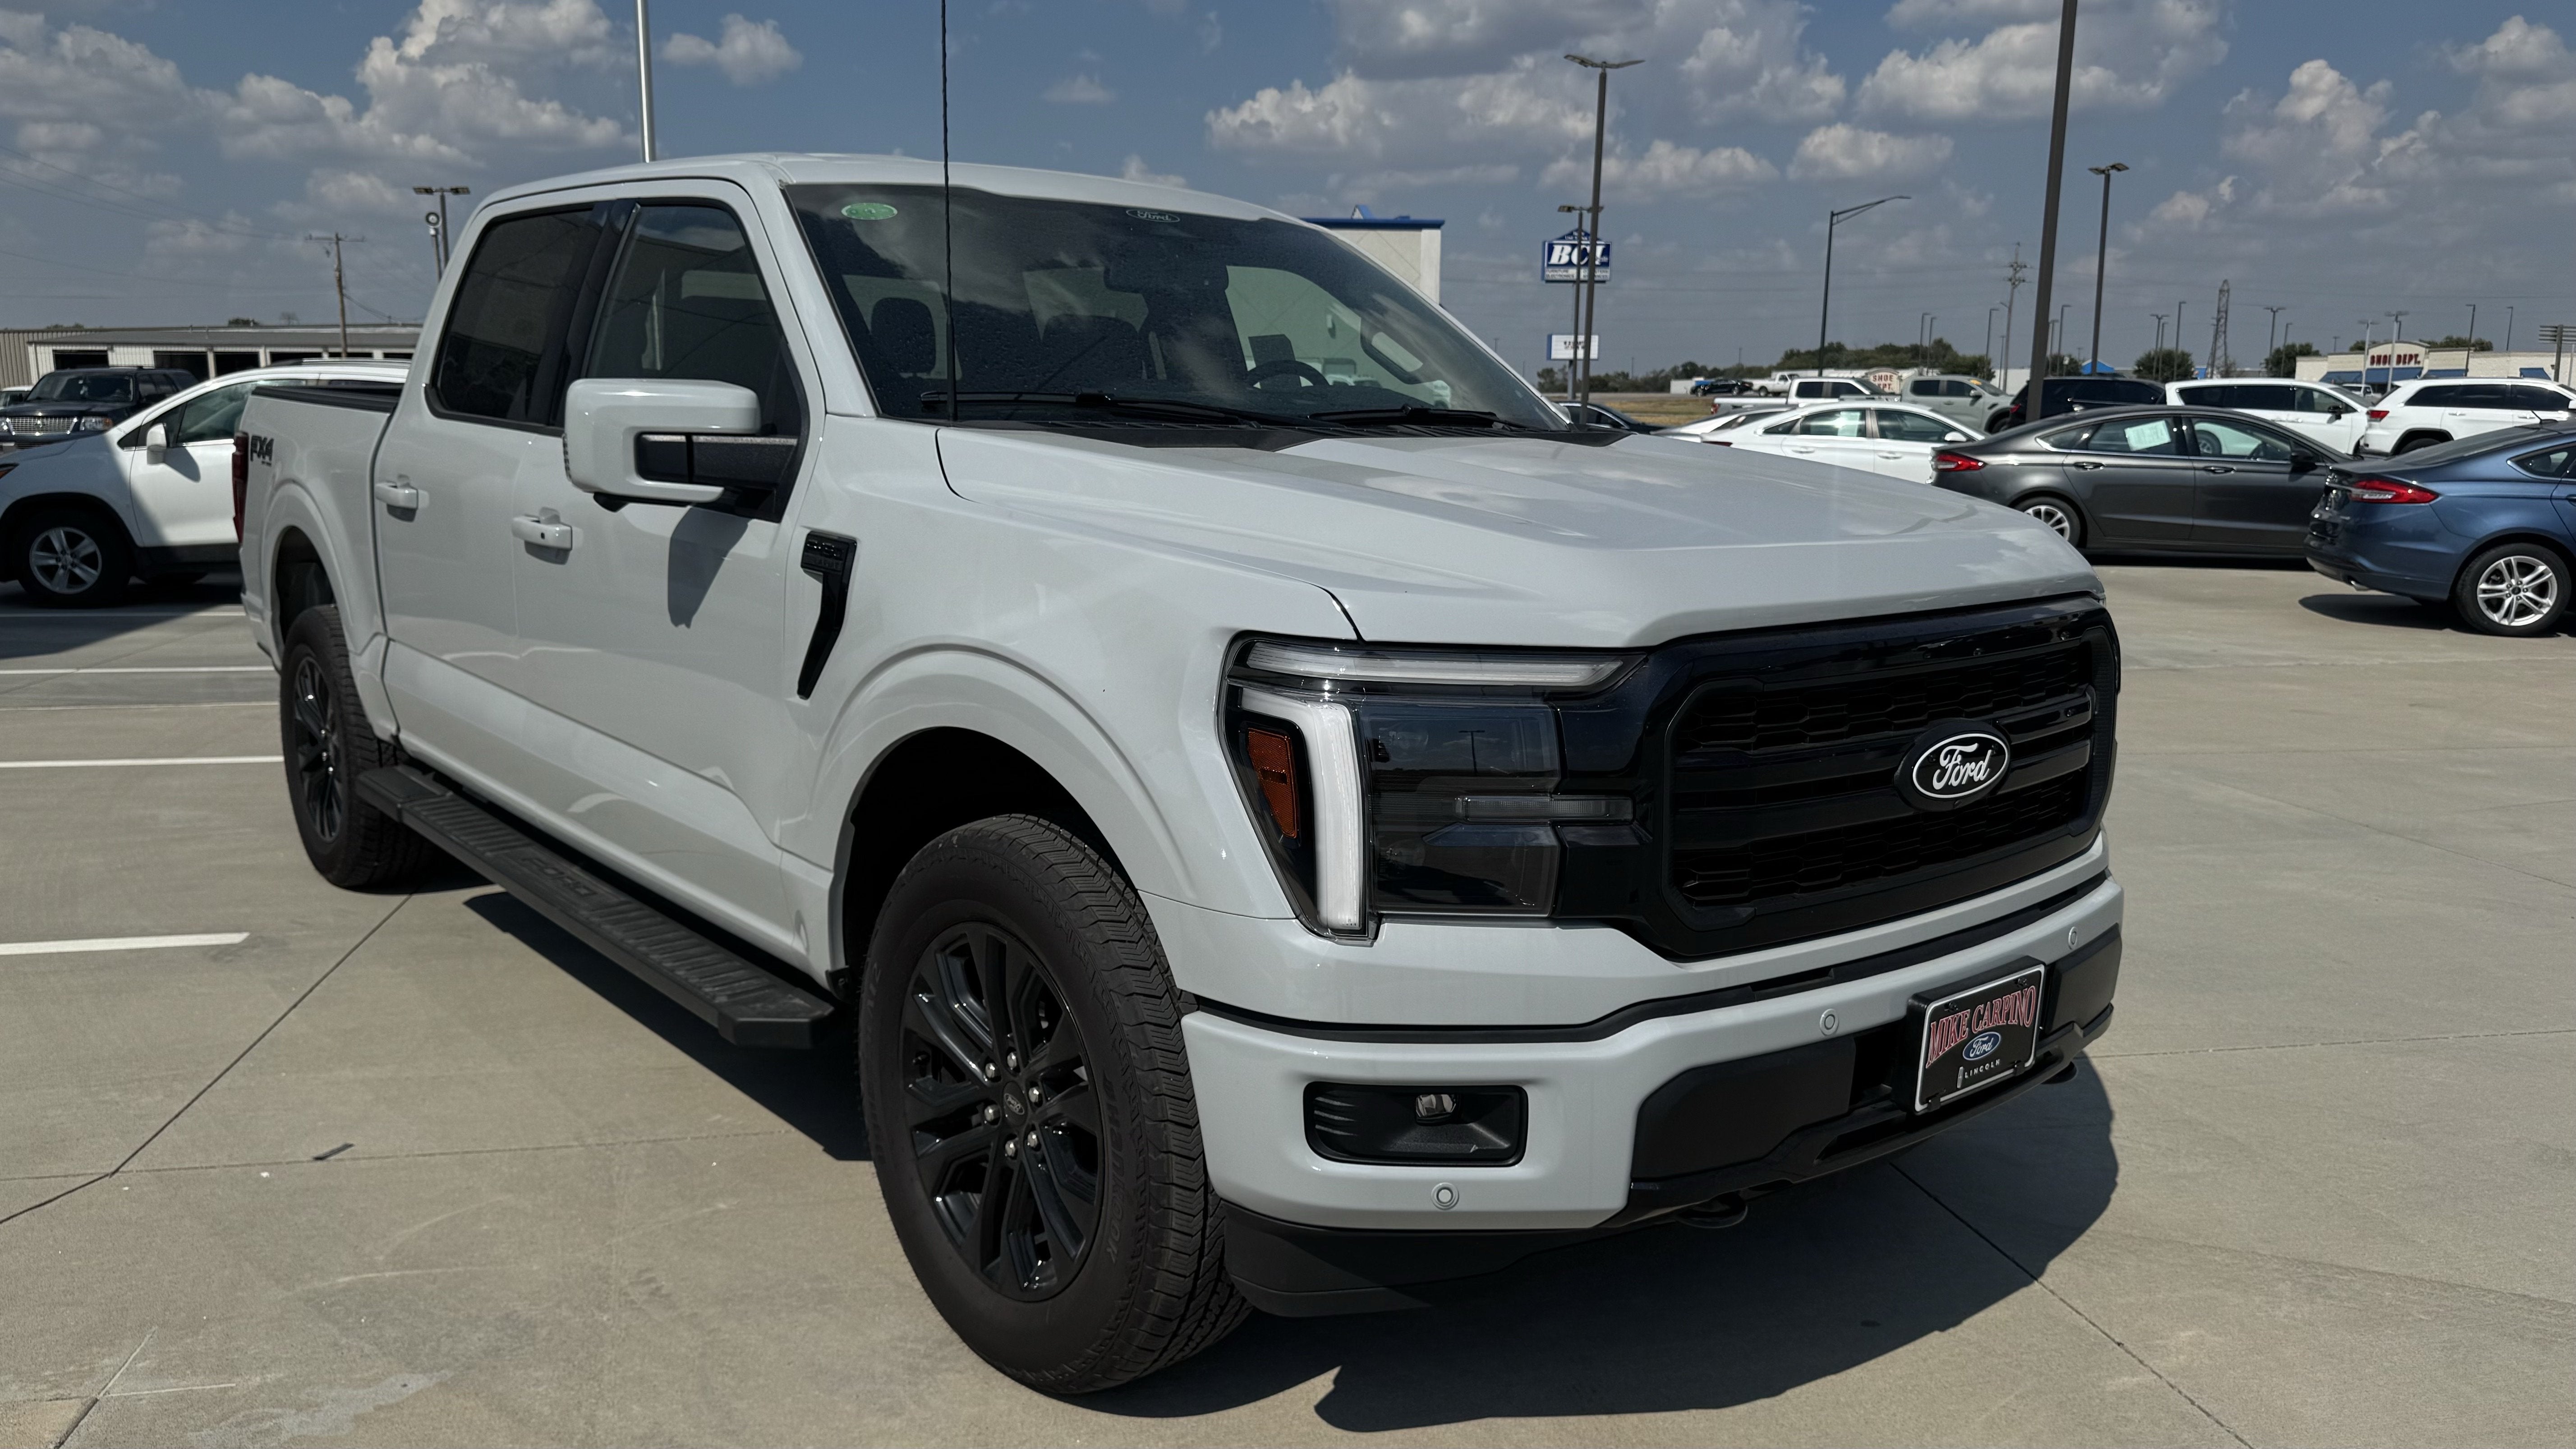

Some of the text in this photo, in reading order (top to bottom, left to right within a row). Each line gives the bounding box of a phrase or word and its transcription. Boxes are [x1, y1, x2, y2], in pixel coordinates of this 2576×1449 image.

[1137, 211, 1172, 221] Ford
[250, 435, 274, 461] FX4
[1932, 743, 1992, 790] Ford
[1926, 985, 2035, 1069] MIKE CARPINO
[1969, 1036, 1994, 1058] Ford
[1964, 1059, 2000, 1079] LINCOLN
